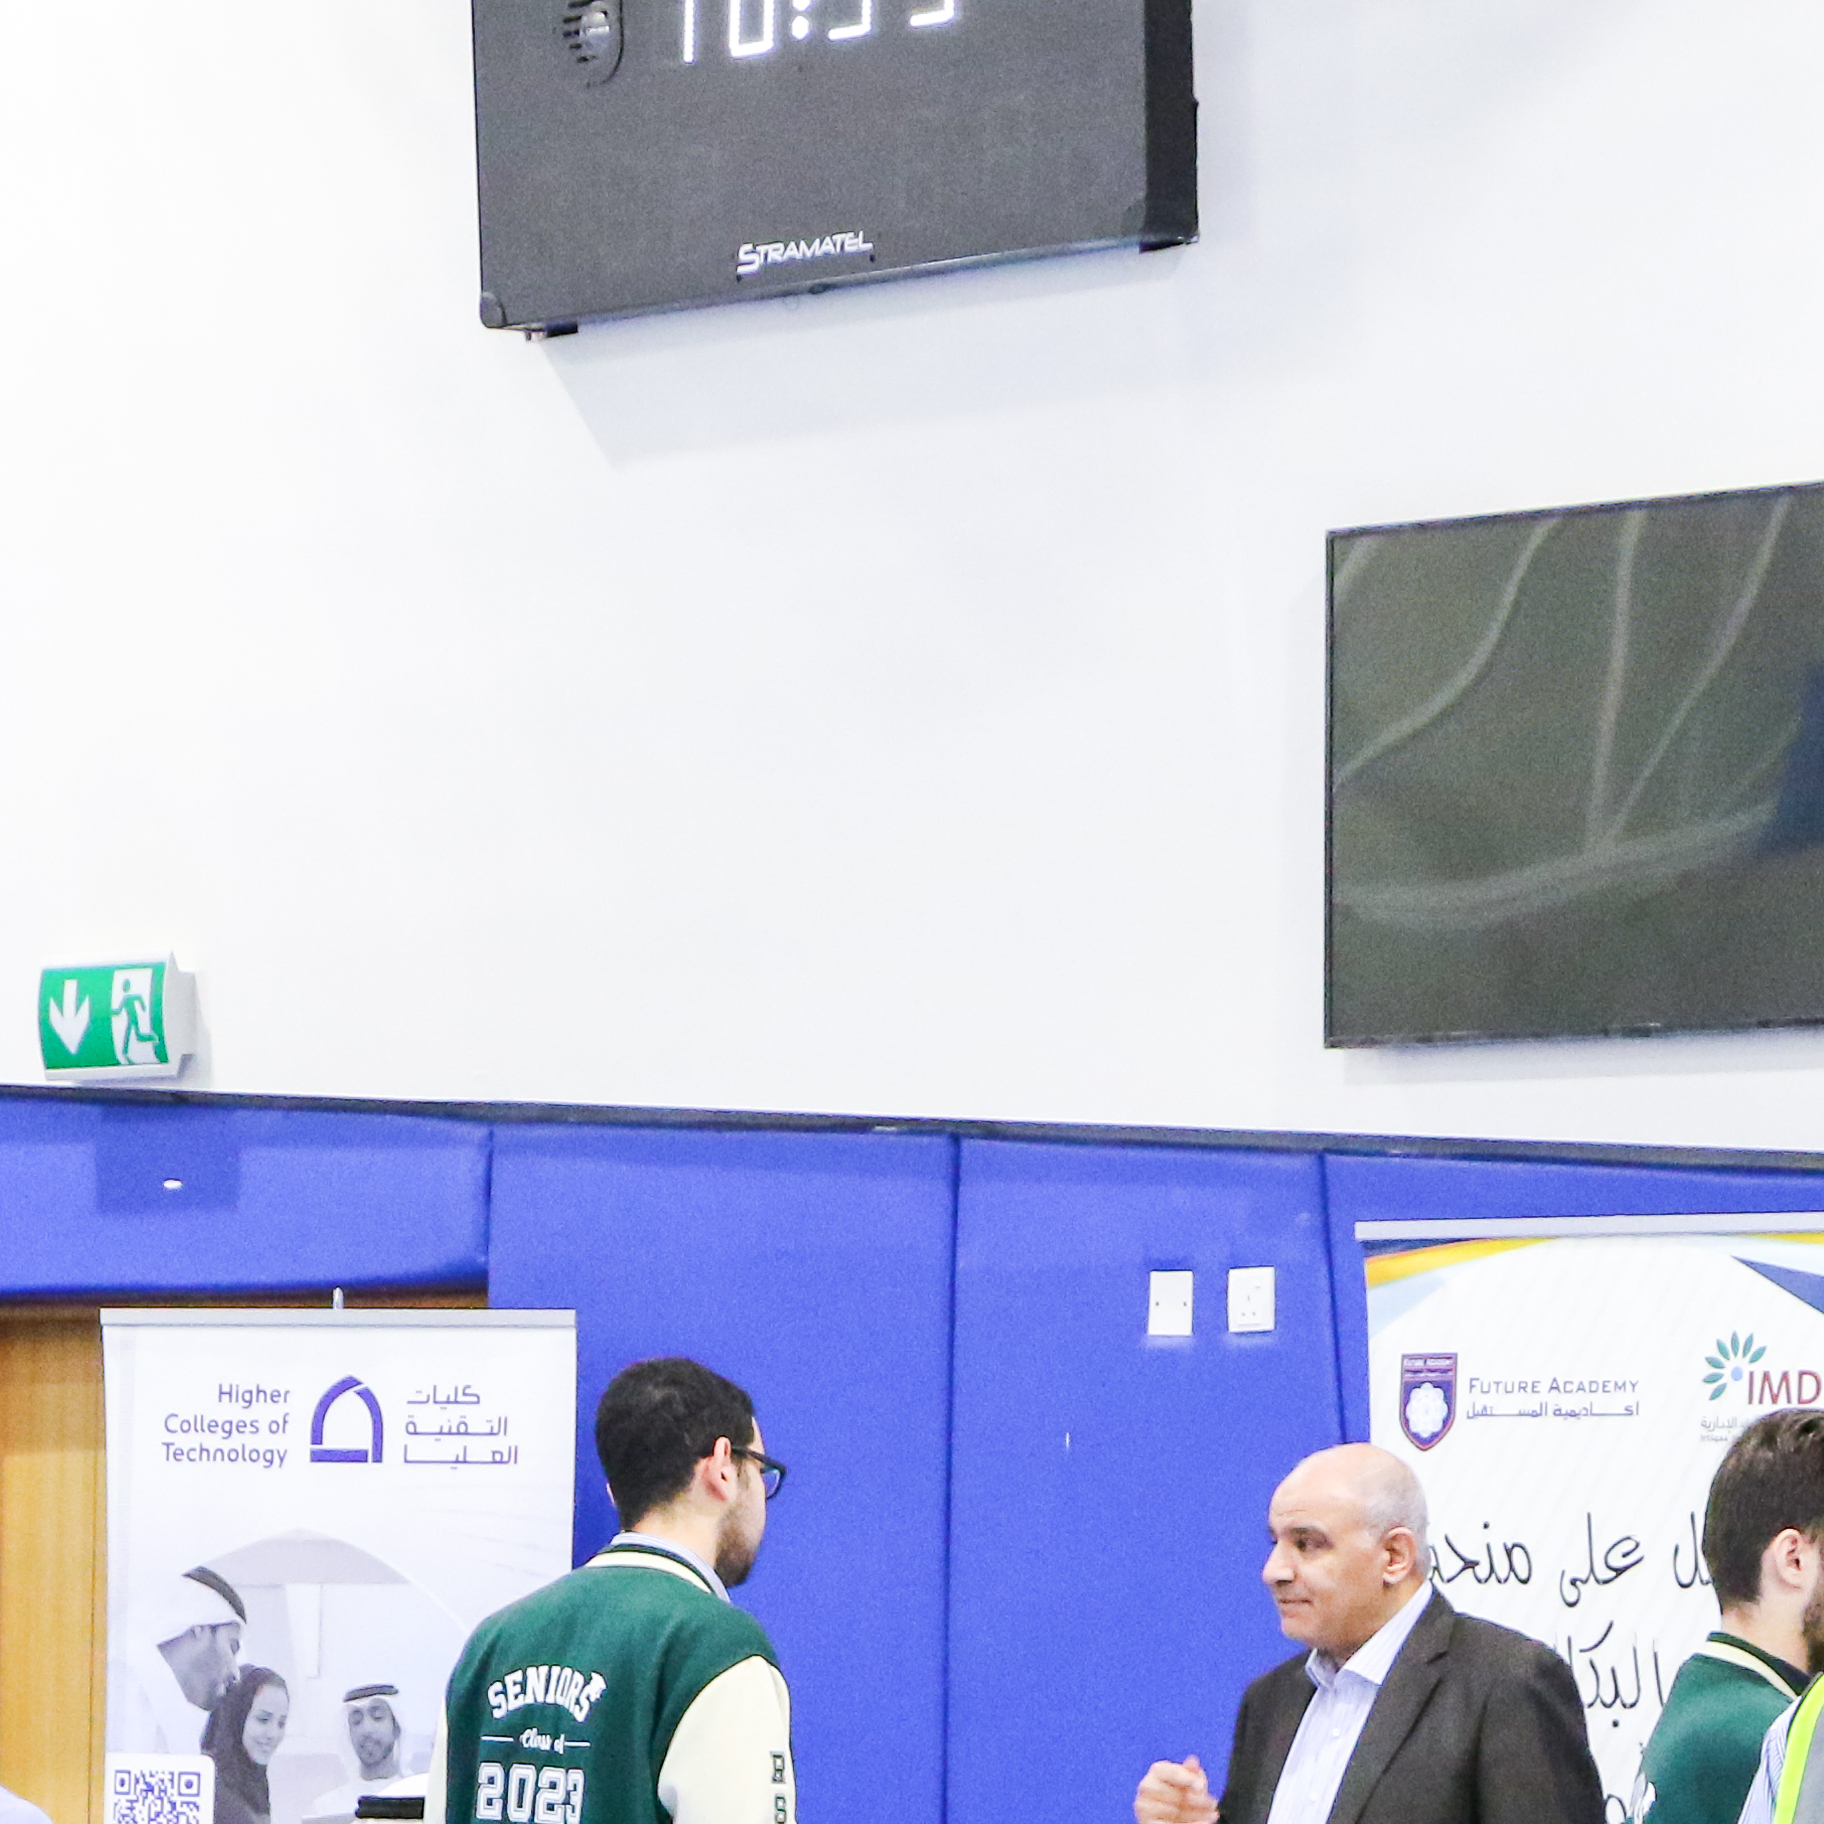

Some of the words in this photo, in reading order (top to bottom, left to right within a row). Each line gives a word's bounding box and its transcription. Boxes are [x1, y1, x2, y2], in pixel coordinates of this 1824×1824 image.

[736, 230, 874, 275] STRAMATEL
[218, 1384, 290, 1409] Higher
[406, 1385, 481, 1410] كليات
[1469, 1377, 1542, 1394] FUTURE
[1547, 1376, 1640, 1394] ACADEMY
[164, 1413, 260, 1440] Colleges
[268, 1413, 290, 1434] of
[405, 1414, 508, 1442] التقنية
[161, 1442, 289, 1468] Technology
[403, 1444, 519, 1470] العليا
[1560, 1511, 1645, 1608] على
[487, 1664, 599, 1723] SENIORS
